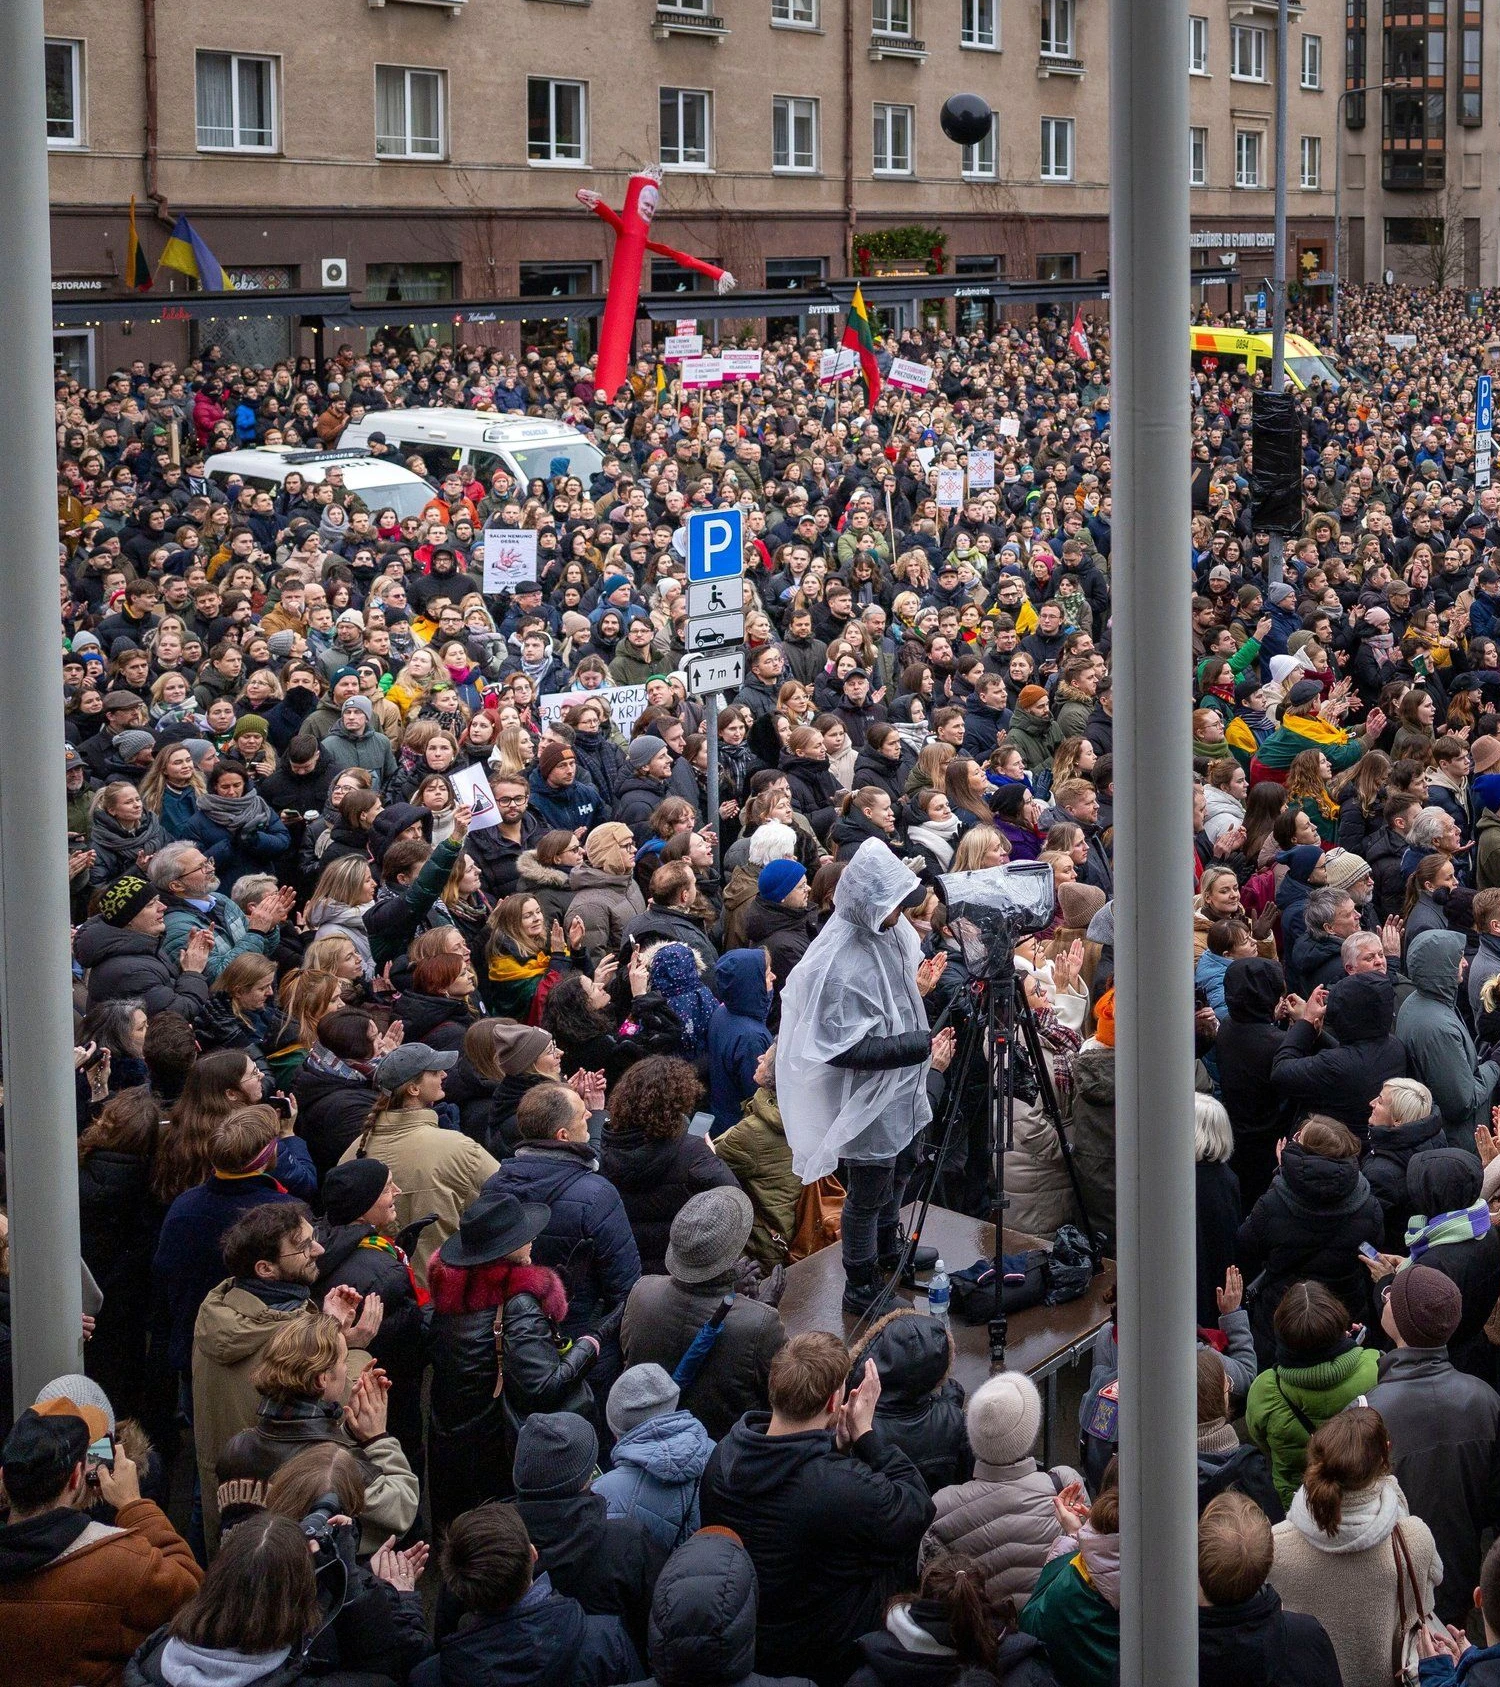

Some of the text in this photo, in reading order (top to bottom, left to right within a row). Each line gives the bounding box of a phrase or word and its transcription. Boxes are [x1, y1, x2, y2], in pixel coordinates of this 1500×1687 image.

[1223, 233, 1231, 247] IR
[961, 287, 991, 296] submarine
[808, 305, 840, 314] ŠVYTURYS
[894, 370, 926, 383] PREZIDENTAS
[1481, 380, 1489, 407] P
[704, 519, 732, 573] P
[708, 668, 727, 681] 7 m
